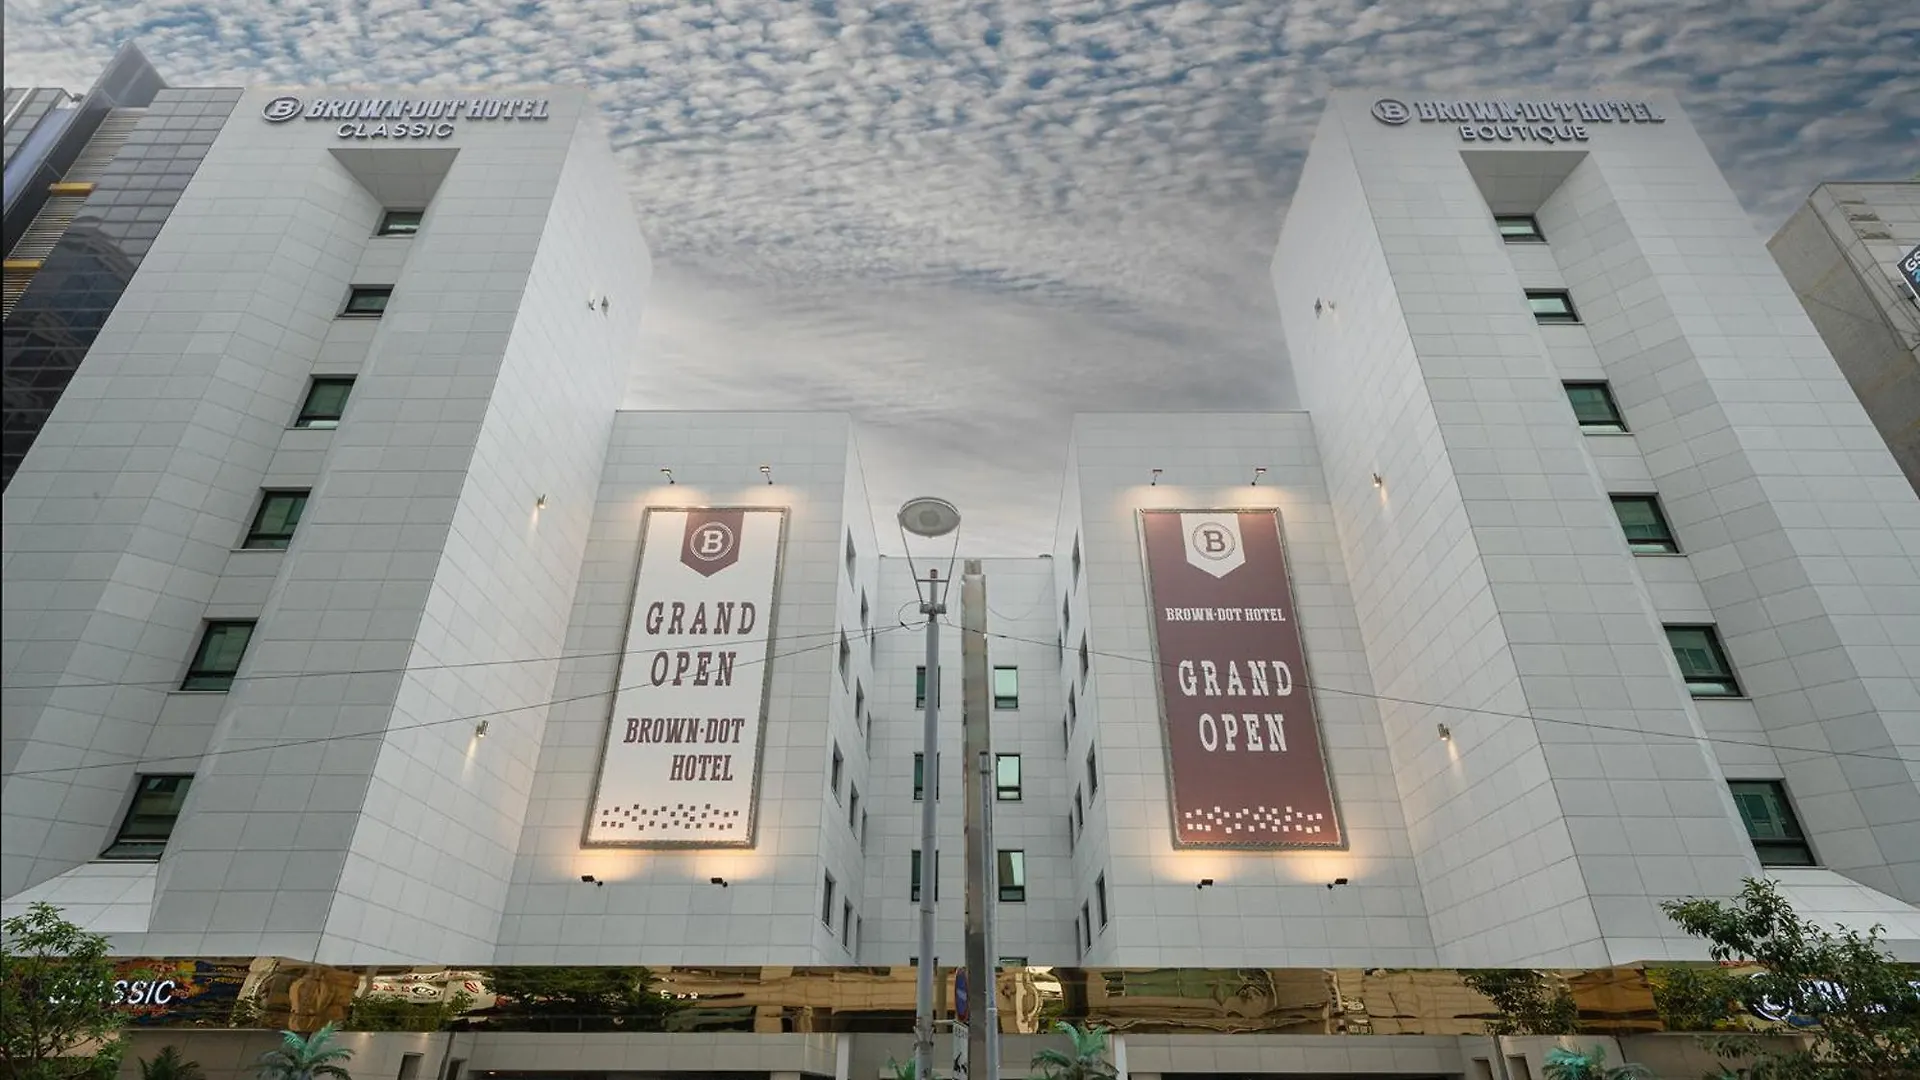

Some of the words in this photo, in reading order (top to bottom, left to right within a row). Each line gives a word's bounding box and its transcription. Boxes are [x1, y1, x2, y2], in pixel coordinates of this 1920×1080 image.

[465, 99, 549, 121] HOTEL
[1574, 100, 1666, 122] HOTEL
[336, 122, 455, 140] CLASSIC
[1459, 124, 1590, 145] BOUTIQUE
[701, 529, 723, 554] B
[1203, 530, 1226, 552] B
[646, 601, 756, 635] GRAND
[1244, 608, 1286, 622] HOTEL
[651, 651, 737, 687] OPEN
[1178, 660, 1293, 696] GRAND
[1198, 713, 1288, 752] OPEN
[669, 754, 734, 781] HOTEL
